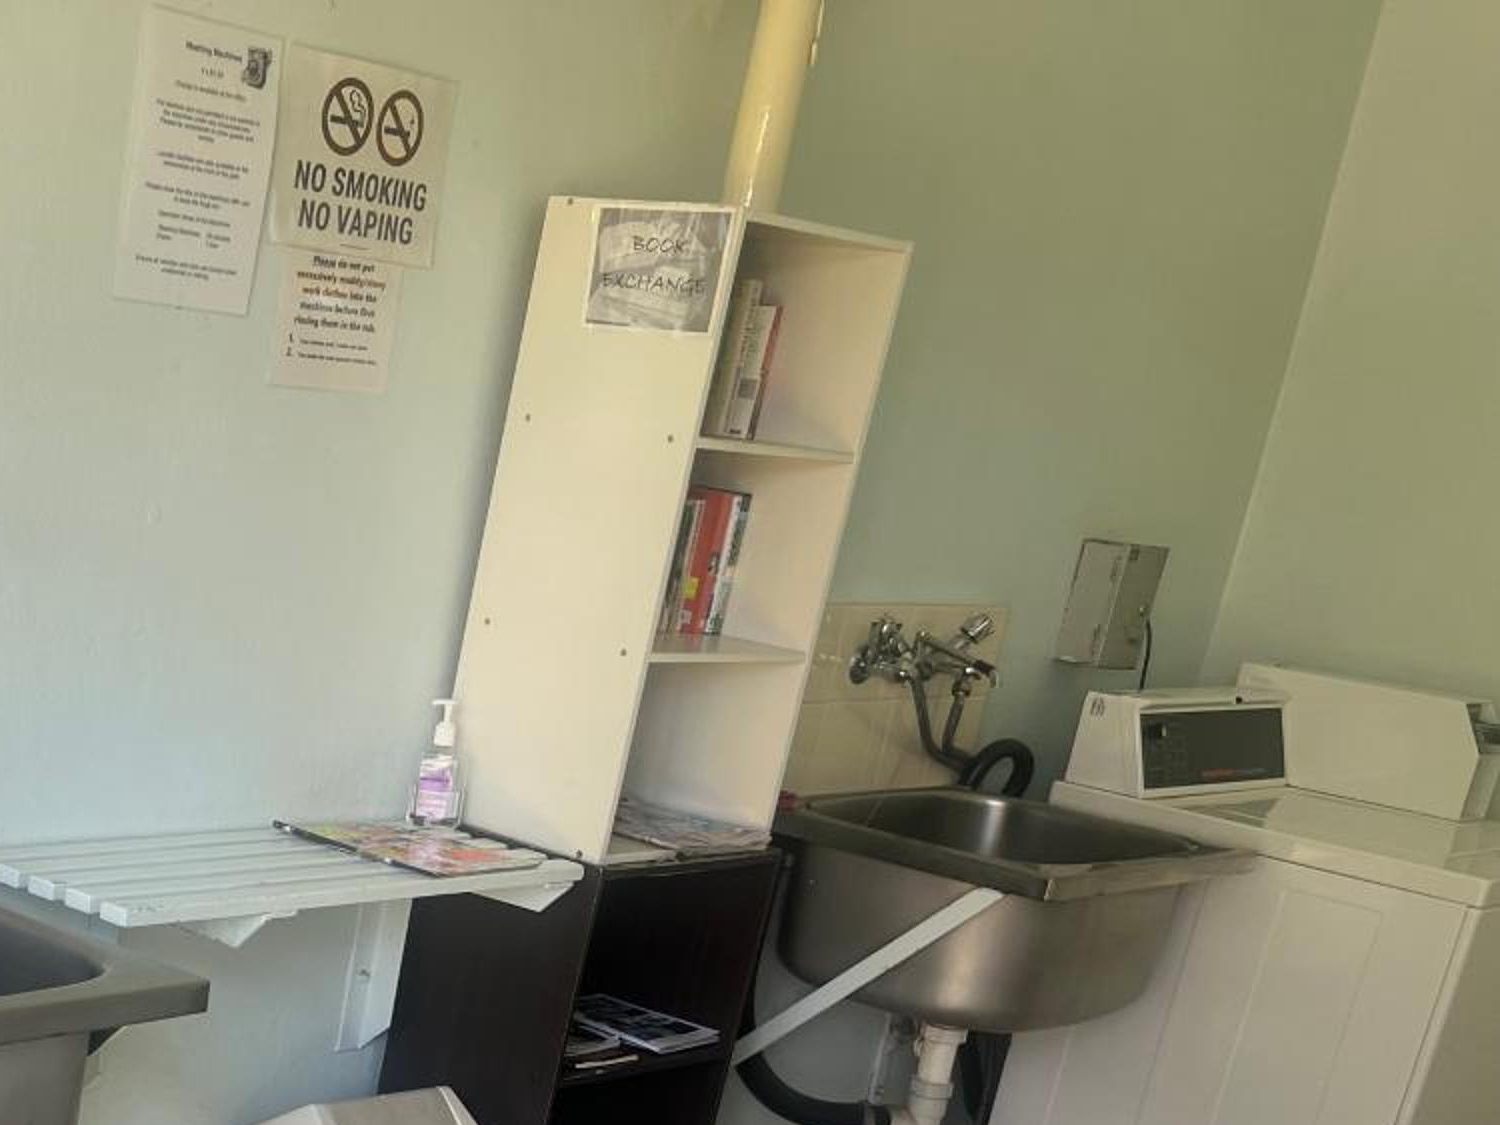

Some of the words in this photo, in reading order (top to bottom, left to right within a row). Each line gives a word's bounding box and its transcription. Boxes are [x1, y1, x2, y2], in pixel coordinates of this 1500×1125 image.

[294, 159, 327, 193] NO
[332, 167, 427, 212] SMOKING
[298, 198, 331, 231] NO
[338, 205, 413, 244] VAPING
[632, 235, 687, 254] BOOK
[313, 255, 336, 269] Please
[338, 261, 347, 270] do
[349, 263, 361, 271] not
[362, 264, 375, 274] put
[603, 272, 707, 297] EXCHANGE
